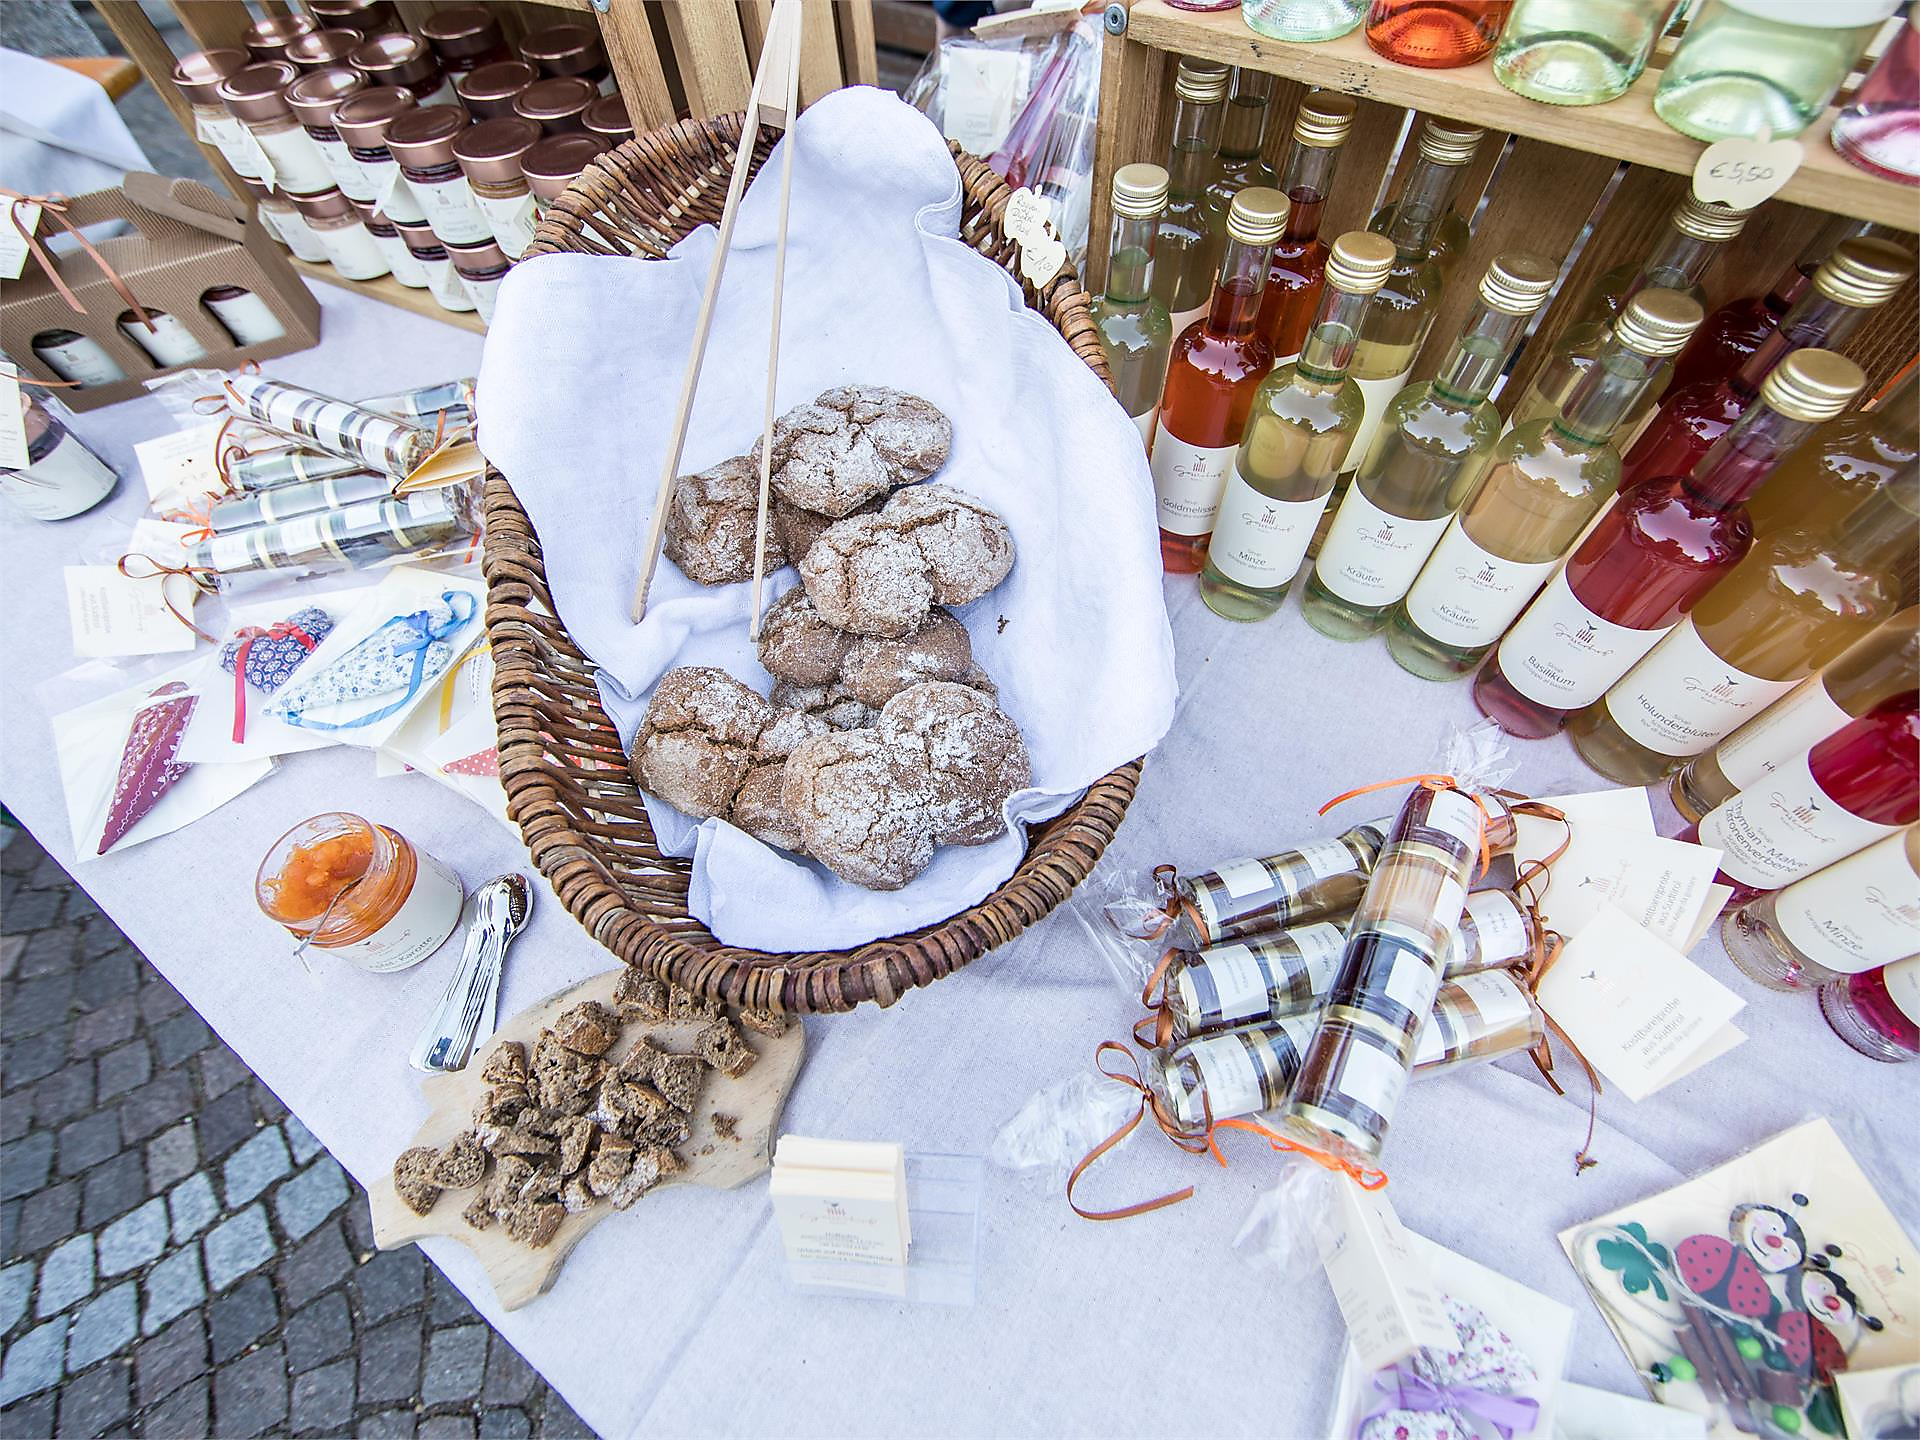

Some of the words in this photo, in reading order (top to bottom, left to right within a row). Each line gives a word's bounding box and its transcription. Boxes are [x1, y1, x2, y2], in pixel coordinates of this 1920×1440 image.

[1162, 497, 1217, 513] Goldmelisse
[1238, 551, 1267, 566] Minze
[1345, 564, 1382, 584] Kräuter
[1439, 604, 1478, 626] Kräuter
[1527, 655, 1576, 687] Basilikum
[1637, 693, 1720, 738] Holunderblüten
[1734, 800, 1762, 851] Thymian
[1822, 920, 1863, 952] Minze
